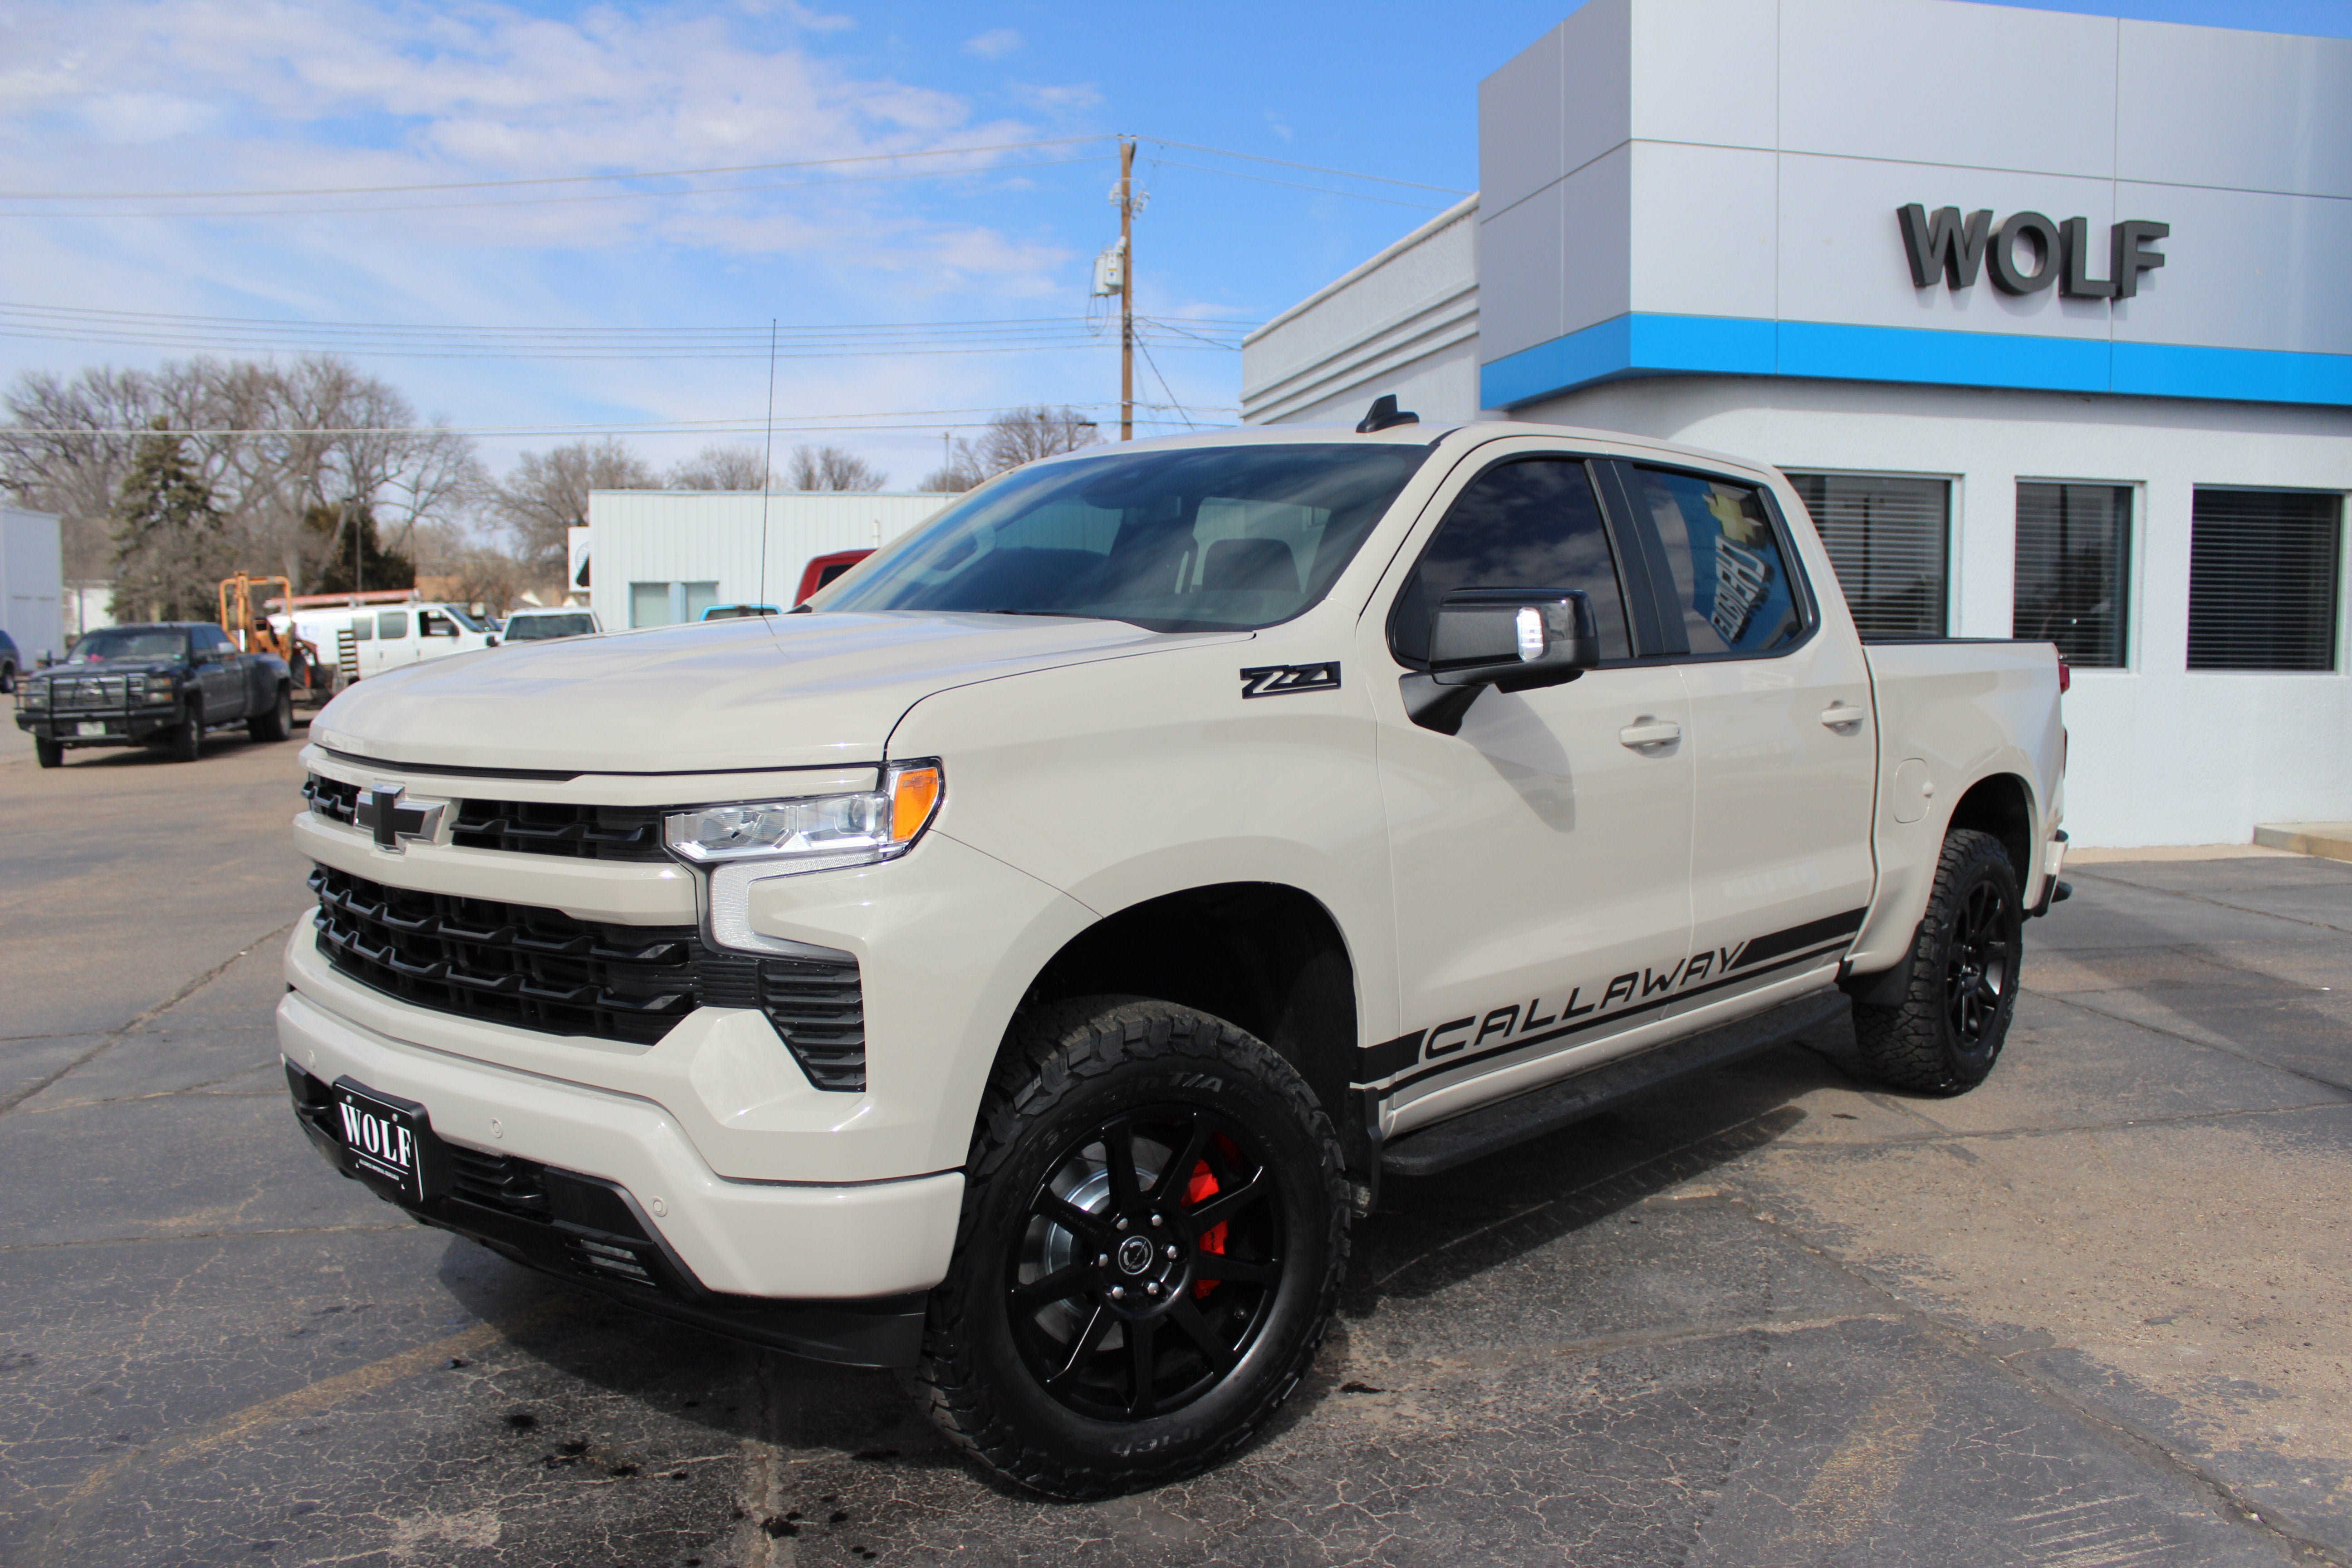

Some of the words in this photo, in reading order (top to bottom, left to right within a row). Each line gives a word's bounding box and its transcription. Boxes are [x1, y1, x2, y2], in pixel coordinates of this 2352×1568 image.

[1897, 202, 2170, 299] WOLF
[1240, 661, 1341, 699] Z71
[1425, 941, 1746, 1059] CALLAWAY
[1169, 1071, 1223, 1093] T/A
[339, 1102, 412, 1167] WOLF
